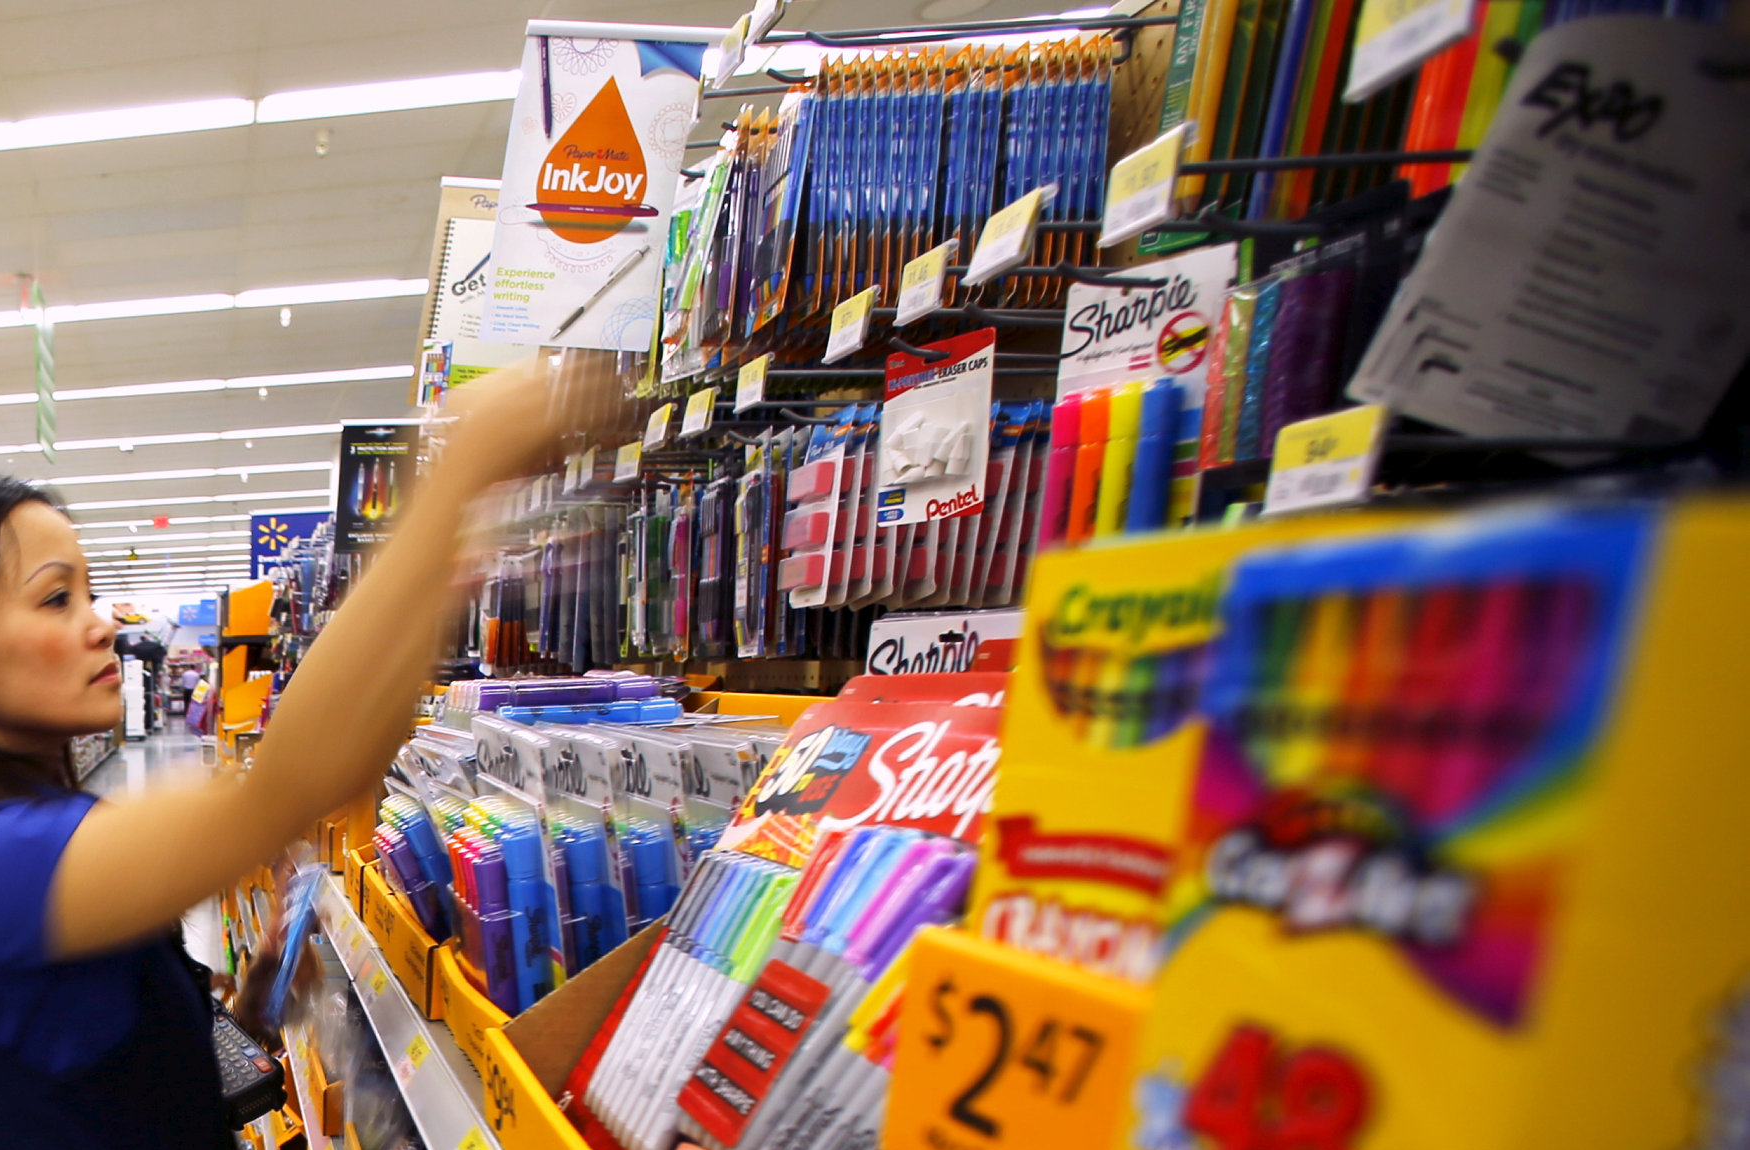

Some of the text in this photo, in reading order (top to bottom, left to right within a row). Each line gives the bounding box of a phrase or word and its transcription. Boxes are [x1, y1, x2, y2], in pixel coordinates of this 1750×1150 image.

[542, 163, 644, 200] InkJoy
[451, 273, 487, 296] Get
[494, 279, 545, 291] effortless
[496, 266, 556, 281] Experience
[493, 291, 530, 304] writing
[1061, 274, 1198, 358] Sharpie
[938, 361, 967, 378] ERASER
[968, 356, 989, 373] CAPS
[926, 483, 981, 520] Pentel
[817, 719, 1004, 839] Sharp
